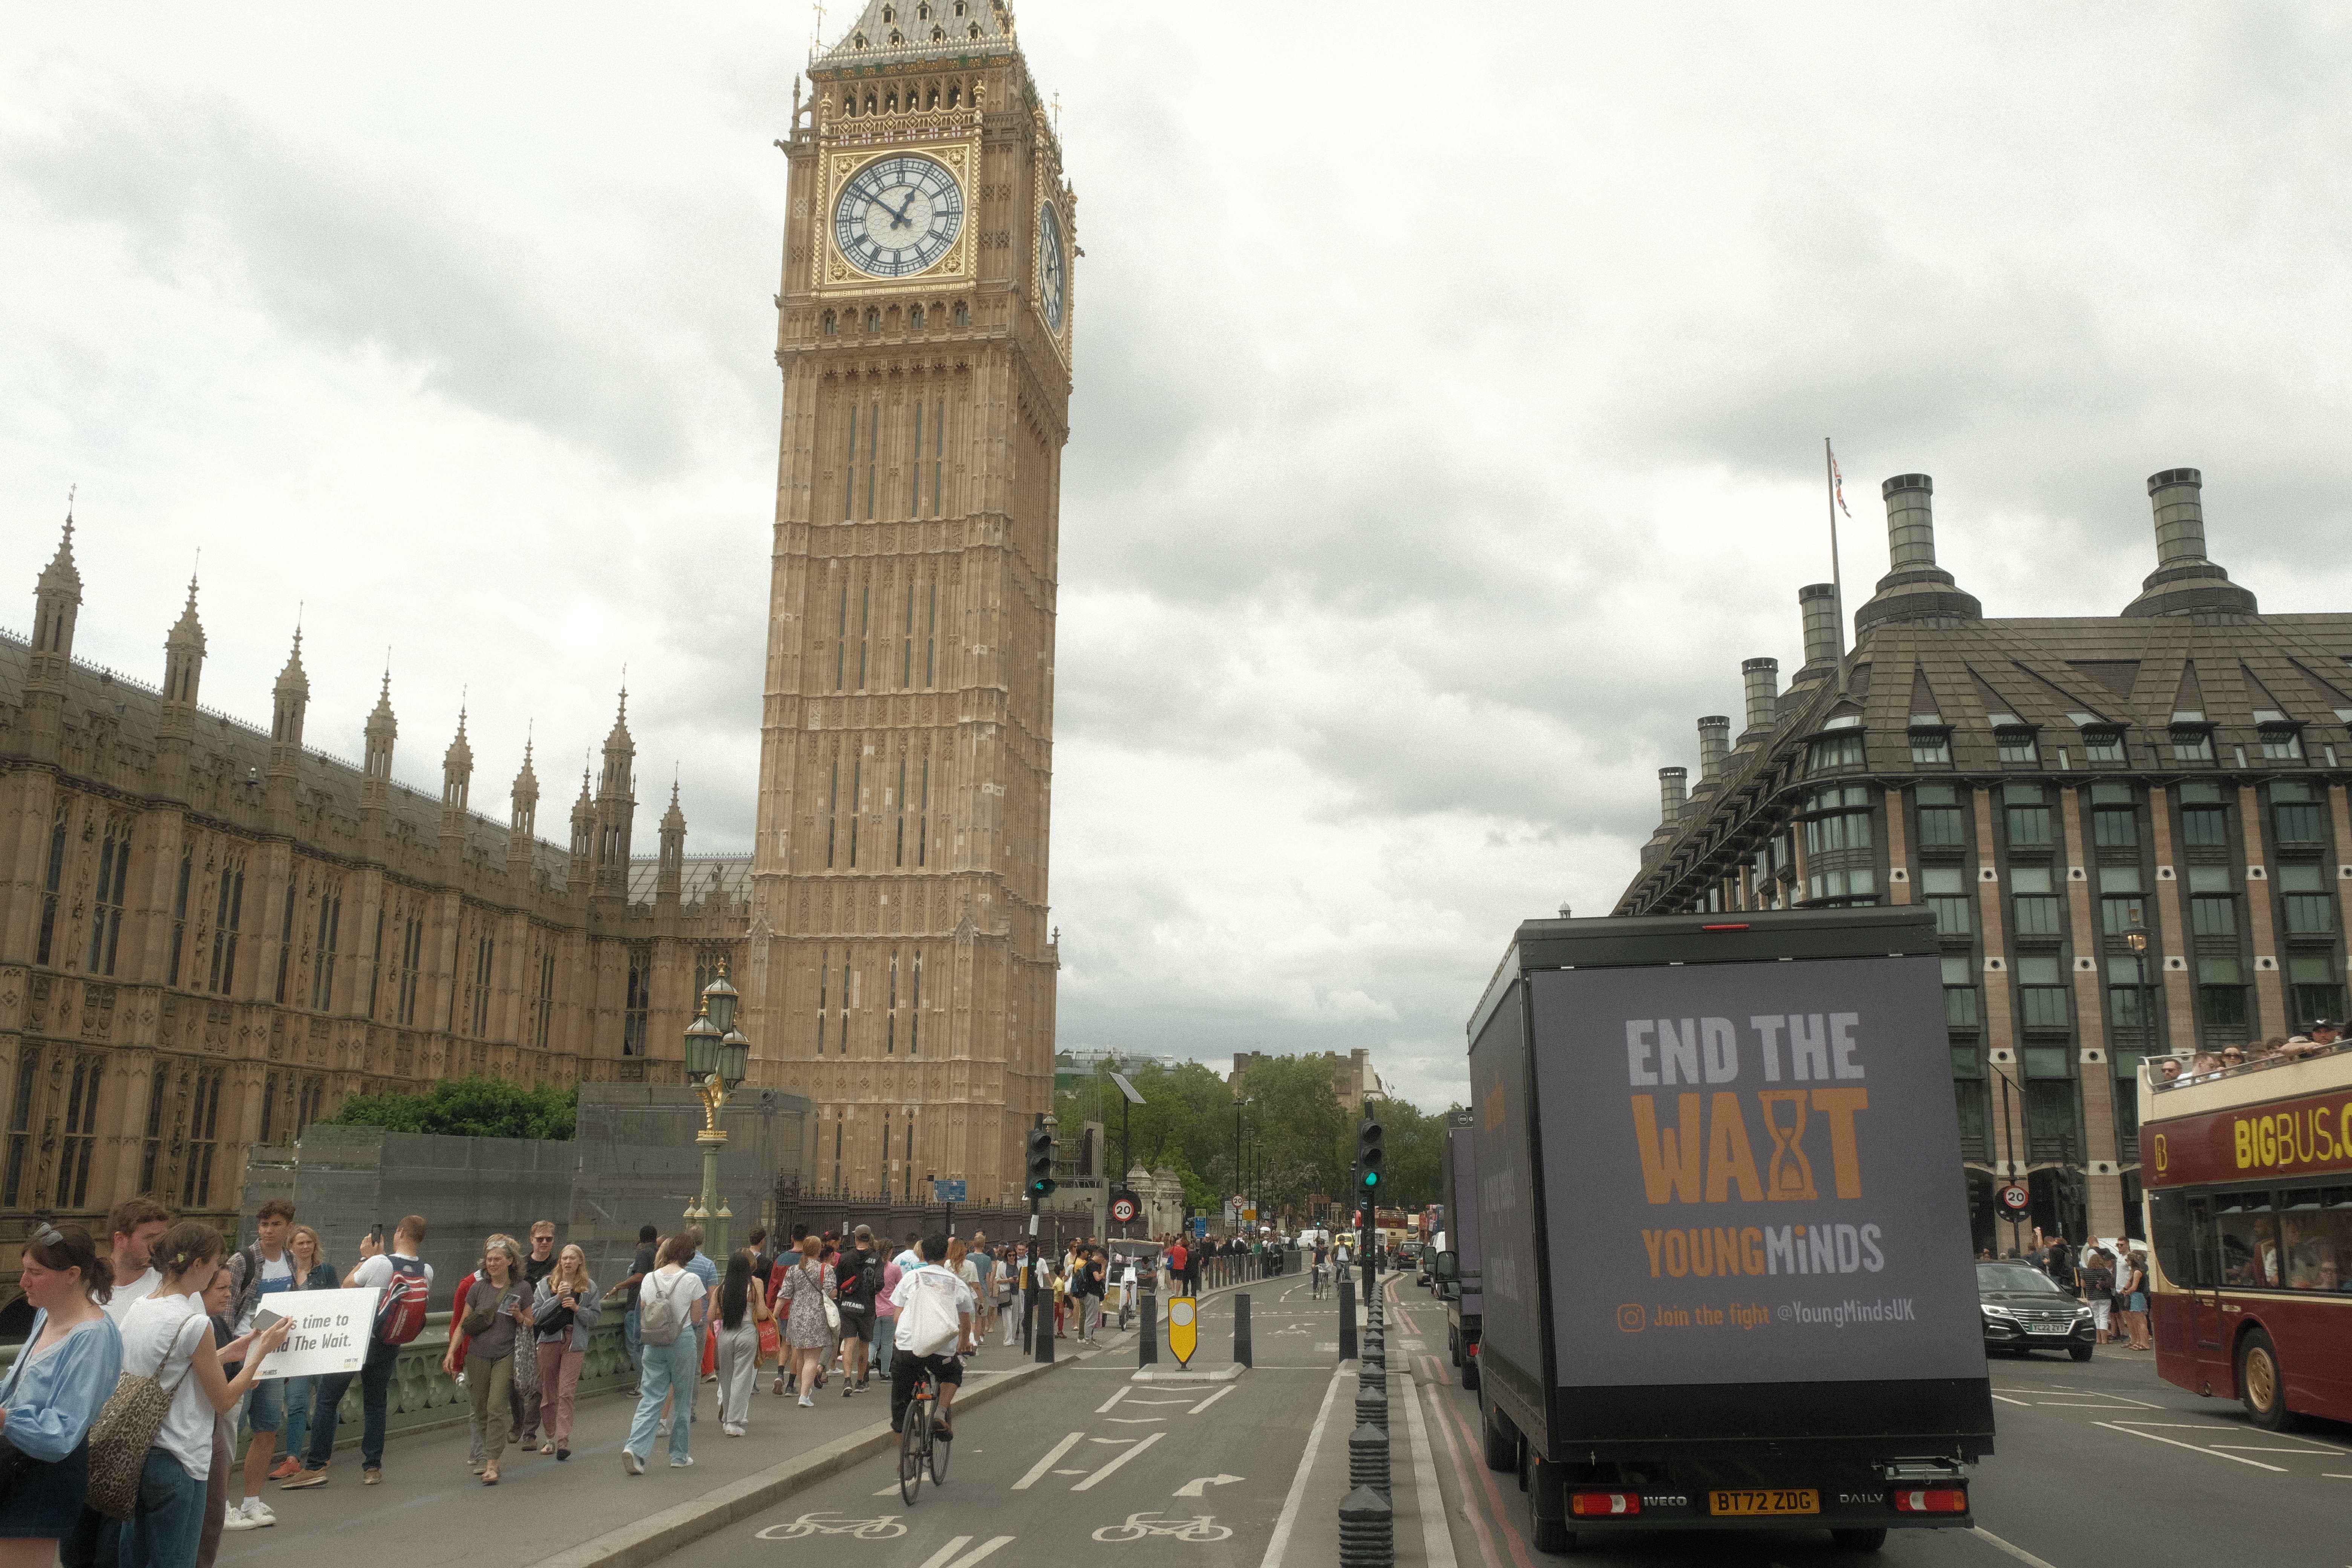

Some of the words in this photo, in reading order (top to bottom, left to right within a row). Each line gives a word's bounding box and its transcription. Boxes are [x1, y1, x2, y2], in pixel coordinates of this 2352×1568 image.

[1626, 1017, 1738, 1086] END
[1750, 1012, 1865, 1081] THE
[2007, 1192, 2024, 1202] 20
[1116, 1205, 1130, 1214] 20
[303, 1314, 331, 1329] time
[336, 1314, 349, 1326] to
[1654, 1304, 1689, 1326] Join
[1695, 1303, 1723, 1326] the
[1729, 1302, 1770, 1331] fight
[1777, 1298, 1915, 1328] @YoungMindsUK
[294, 1335, 317, 1351] The
[322, 1332, 351, 1349] Wait.
[1643, 1496, 1687, 1507] IVECO
[1717, 1492, 1768, 1511] BT72
[1774, 1491, 1811, 1510] ZDG
